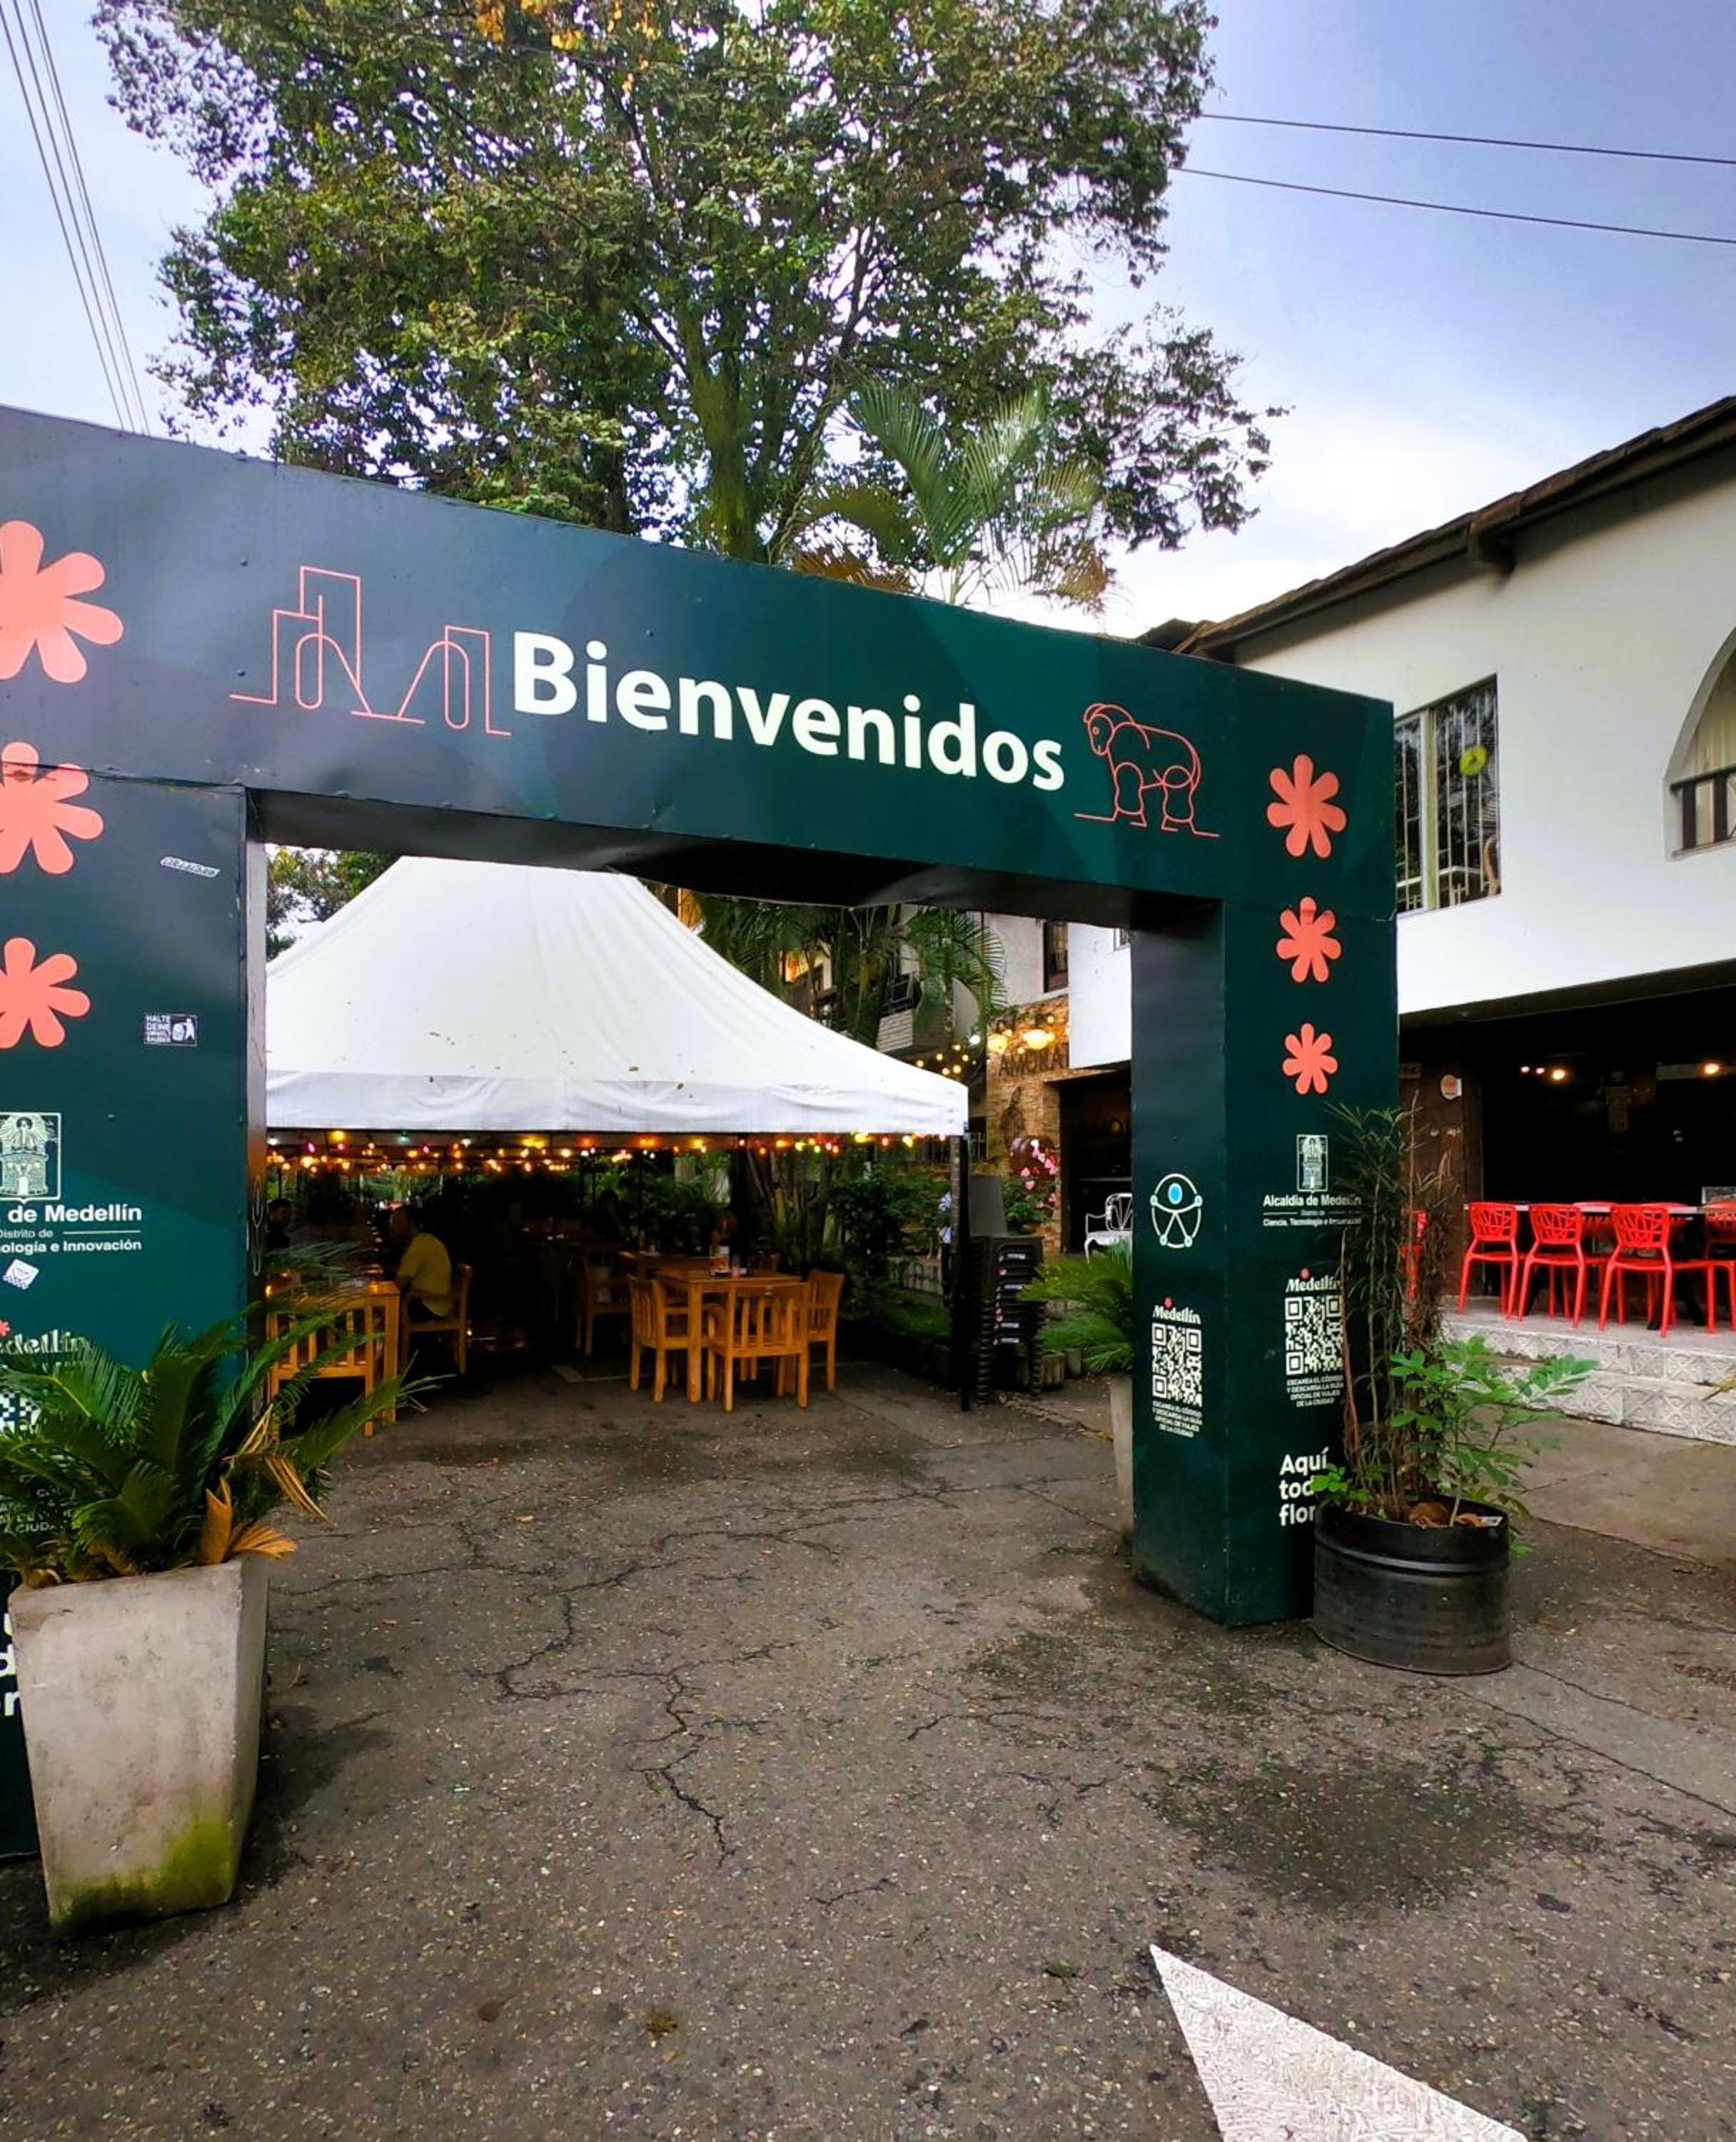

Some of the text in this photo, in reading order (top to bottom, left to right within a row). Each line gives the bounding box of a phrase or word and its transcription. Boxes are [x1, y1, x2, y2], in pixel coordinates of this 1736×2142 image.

[513, 631, 1065, 792] Bienvenidos
[1263, 1194, 1304, 1207] Alcaldía
[1306, 1195, 1318, 1206] de
[8, 1204, 142, 1222] de Medellín
[39, 1229, 54, 1239] de
[0, 1240, 142, 1256] ología e Innovación
[1152, 1305, 1201, 1325] Medellín
[0, 1329, 90, 1355] dellín
[1279, 1446, 1329, 1477] Aquí
[1279, 1475, 1315, 1499] tod
[1279, 1503, 1316, 1527] flor
